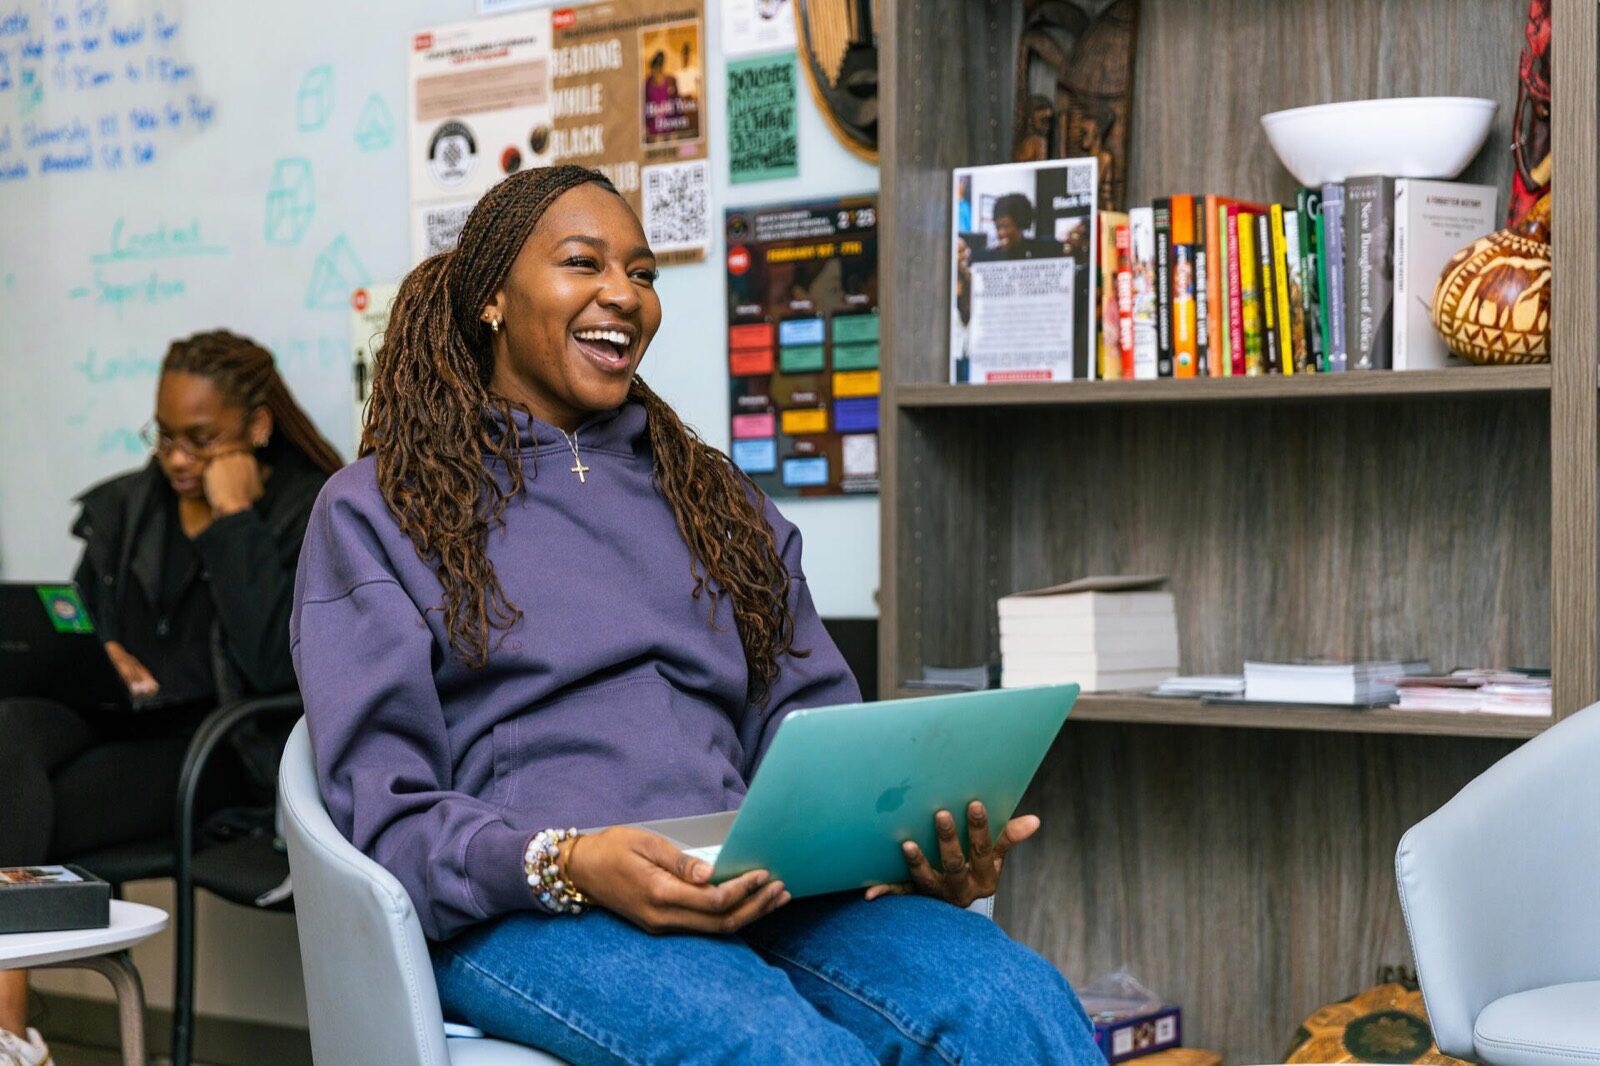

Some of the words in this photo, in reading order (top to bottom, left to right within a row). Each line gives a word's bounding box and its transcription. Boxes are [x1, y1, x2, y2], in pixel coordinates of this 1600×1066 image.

[552, 38, 622, 77] READING
[551, 83, 602, 116] WHILE
[551, 123, 604, 159] BLACK
[1361, 202, 1372, 229] New
[1359, 233, 1372, 298] Daughters
[1361, 299, 1372, 314] of
[1360, 316, 1372, 352] Africa
